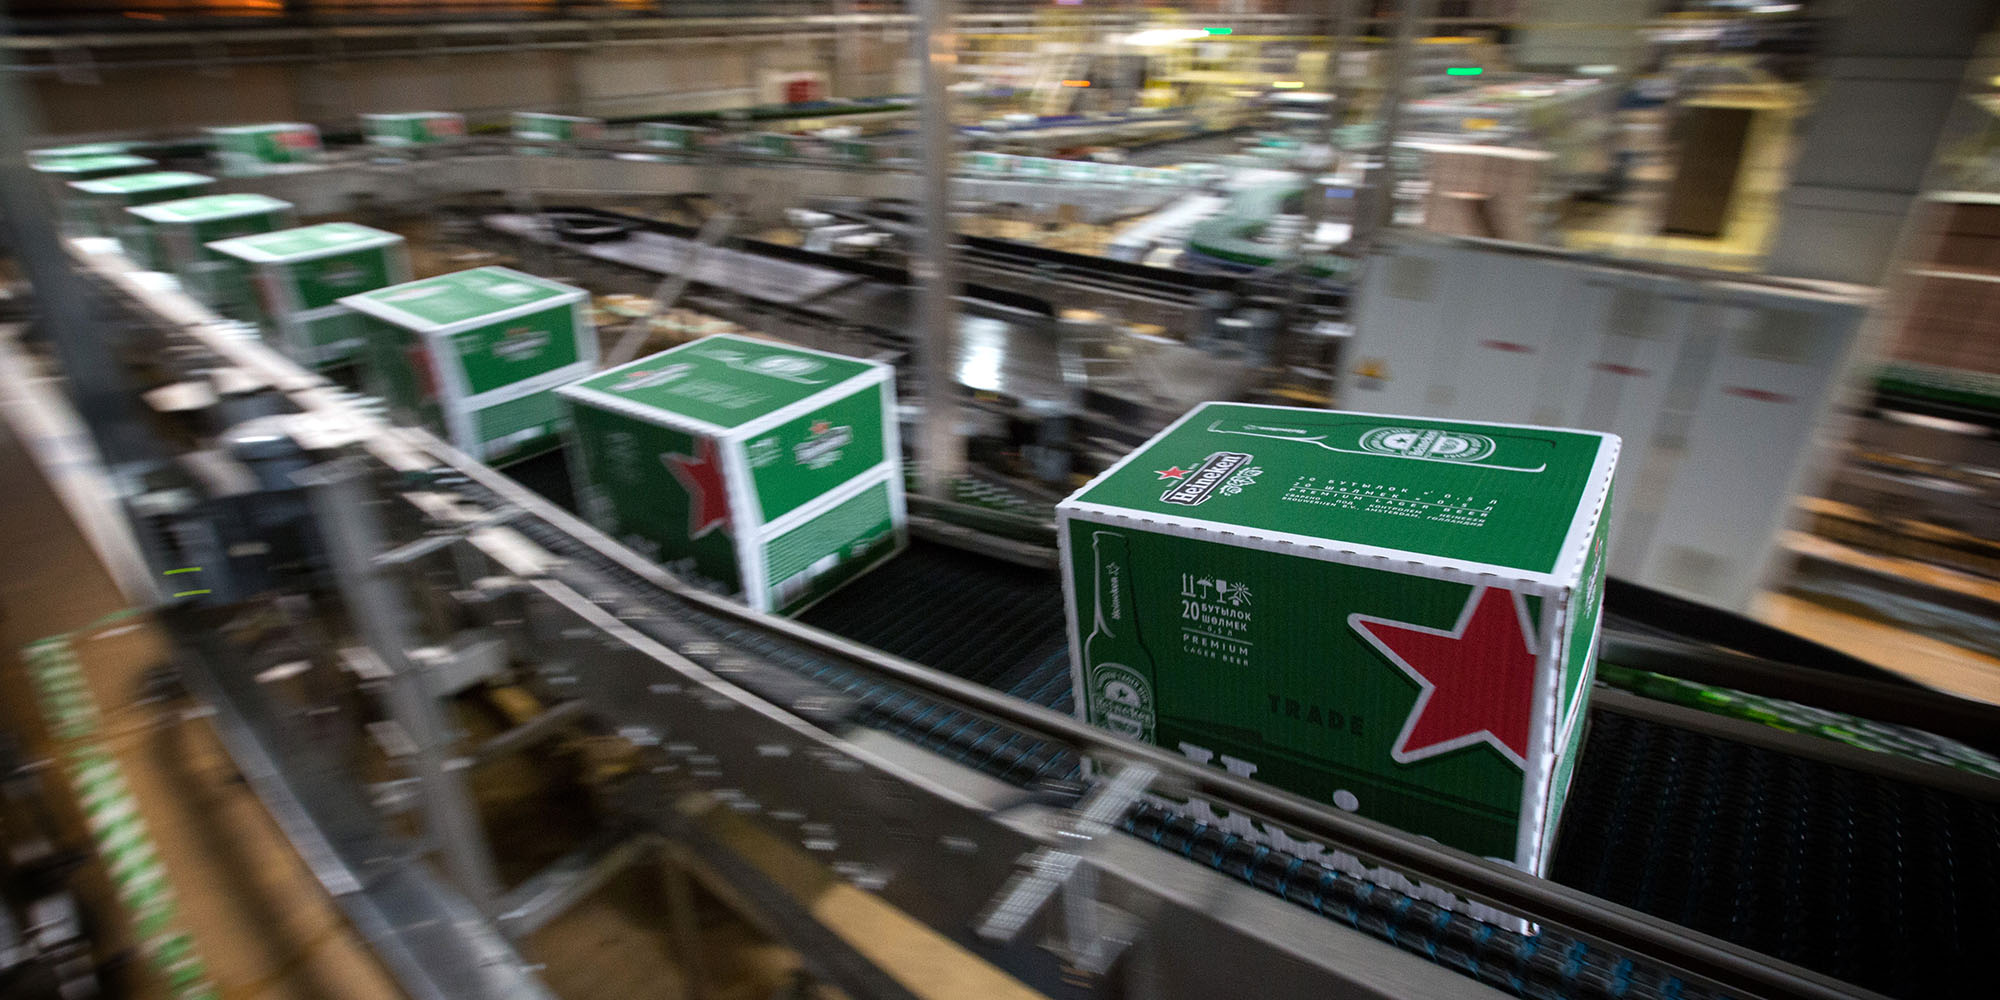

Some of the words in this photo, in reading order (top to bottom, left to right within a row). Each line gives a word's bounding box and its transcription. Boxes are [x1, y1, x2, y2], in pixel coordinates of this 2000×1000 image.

[1169, 454, 1243, 503] Heineken
[1327, 479, 1408, 494] БУТЫЛОК
[1288, 488, 1363, 501] PREMIUM
[1375, 498, 1430, 510] LAGER
[1443, 507, 1489, 518] BEER
[1181, 599, 1200, 620] 20
[1201, 602, 1252, 622] БУТЫЛОК
[1183, 633, 1249, 657] PREMIUM
[1183, 645, 1216, 660] LAGER
[1222, 654, 1249, 668] BEER
[1267, 693, 1365, 738] TRADE
